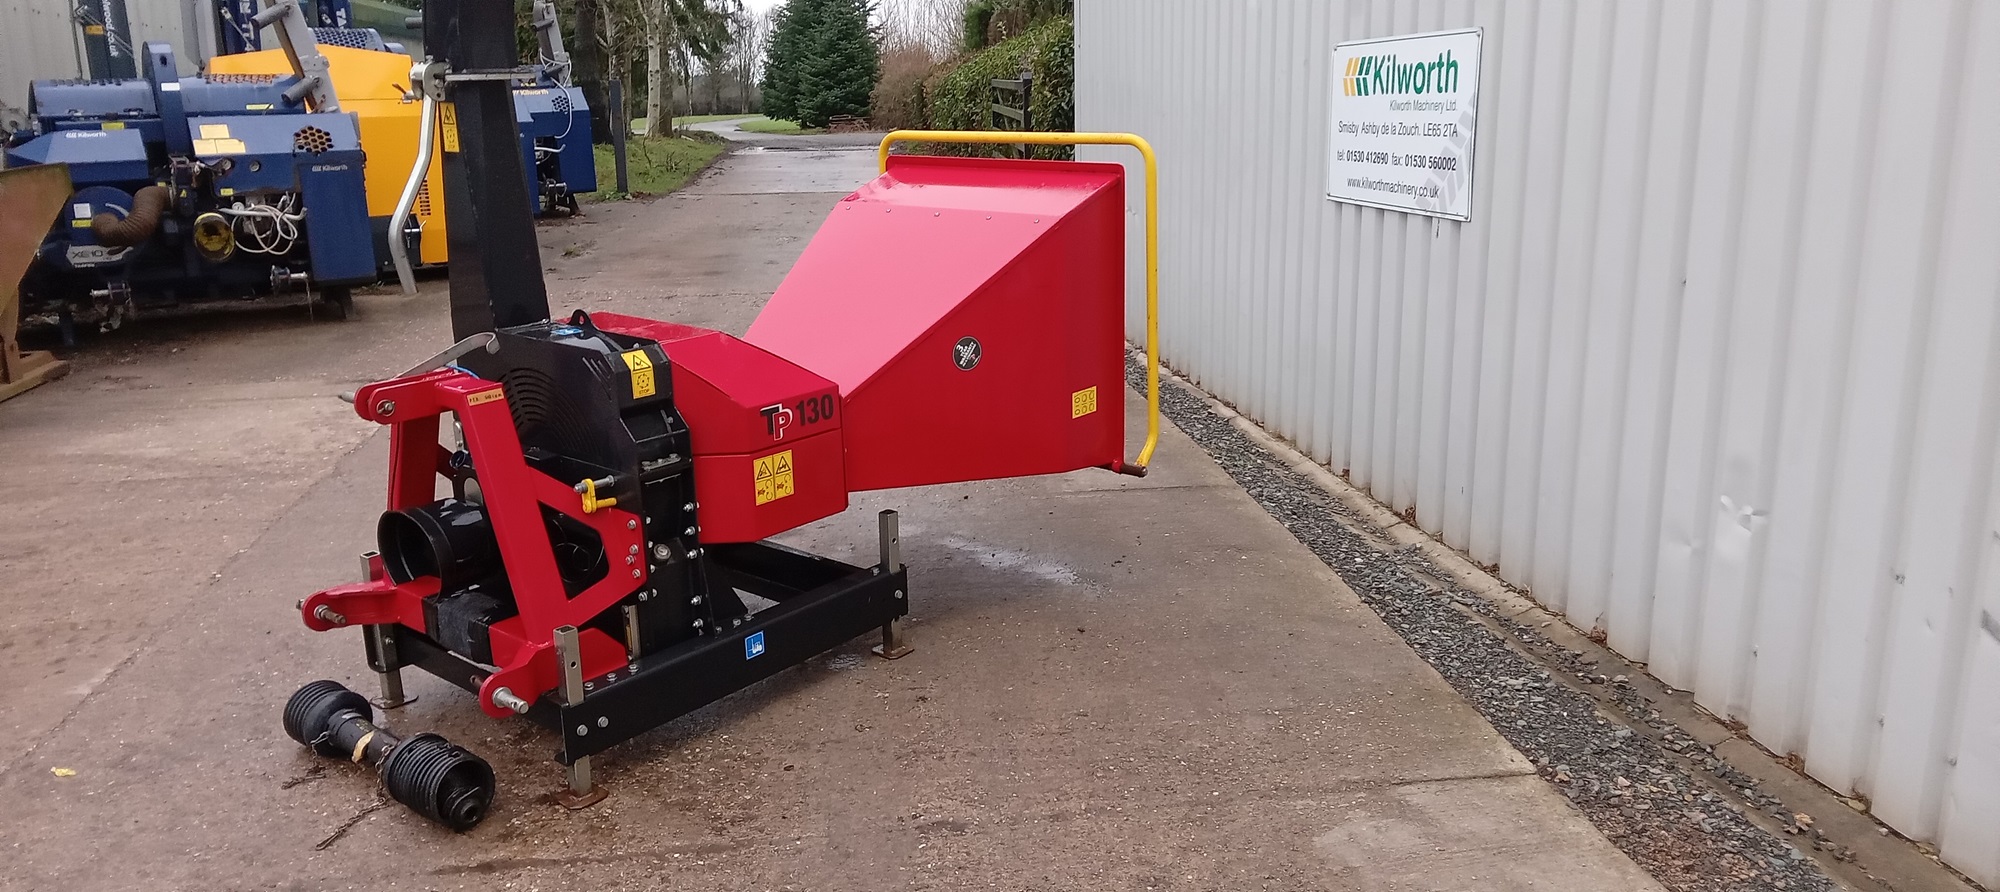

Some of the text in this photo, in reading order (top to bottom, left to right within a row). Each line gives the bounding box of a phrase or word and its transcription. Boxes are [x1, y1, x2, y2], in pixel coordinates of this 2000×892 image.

[1372, 49, 1459, 96] Kilworth
[1389, 99, 1458, 114] Kilworth Machinery Ltd.
[1338, 120, 1360, 137] Smisby
[1360, 122, 1381, 138] Ashby
[1381, 122, 1390, 135] de
[1391, 123, 1397, 136] la
[1423, 122, 1442, 138] LE65
[1443, 123, 1459, 138] 2TA
[1347, 150, 1365, 163] 01530
[1365, 151, 1389, 165] 412690
[1404, 154, 1427, 169] 01530
[1428, 156, 1457, 171] 560002
[1346, 176, 1440, 200] www.kilworthmachinery.co.uk
[760, 394, 834, 441] TP 130
